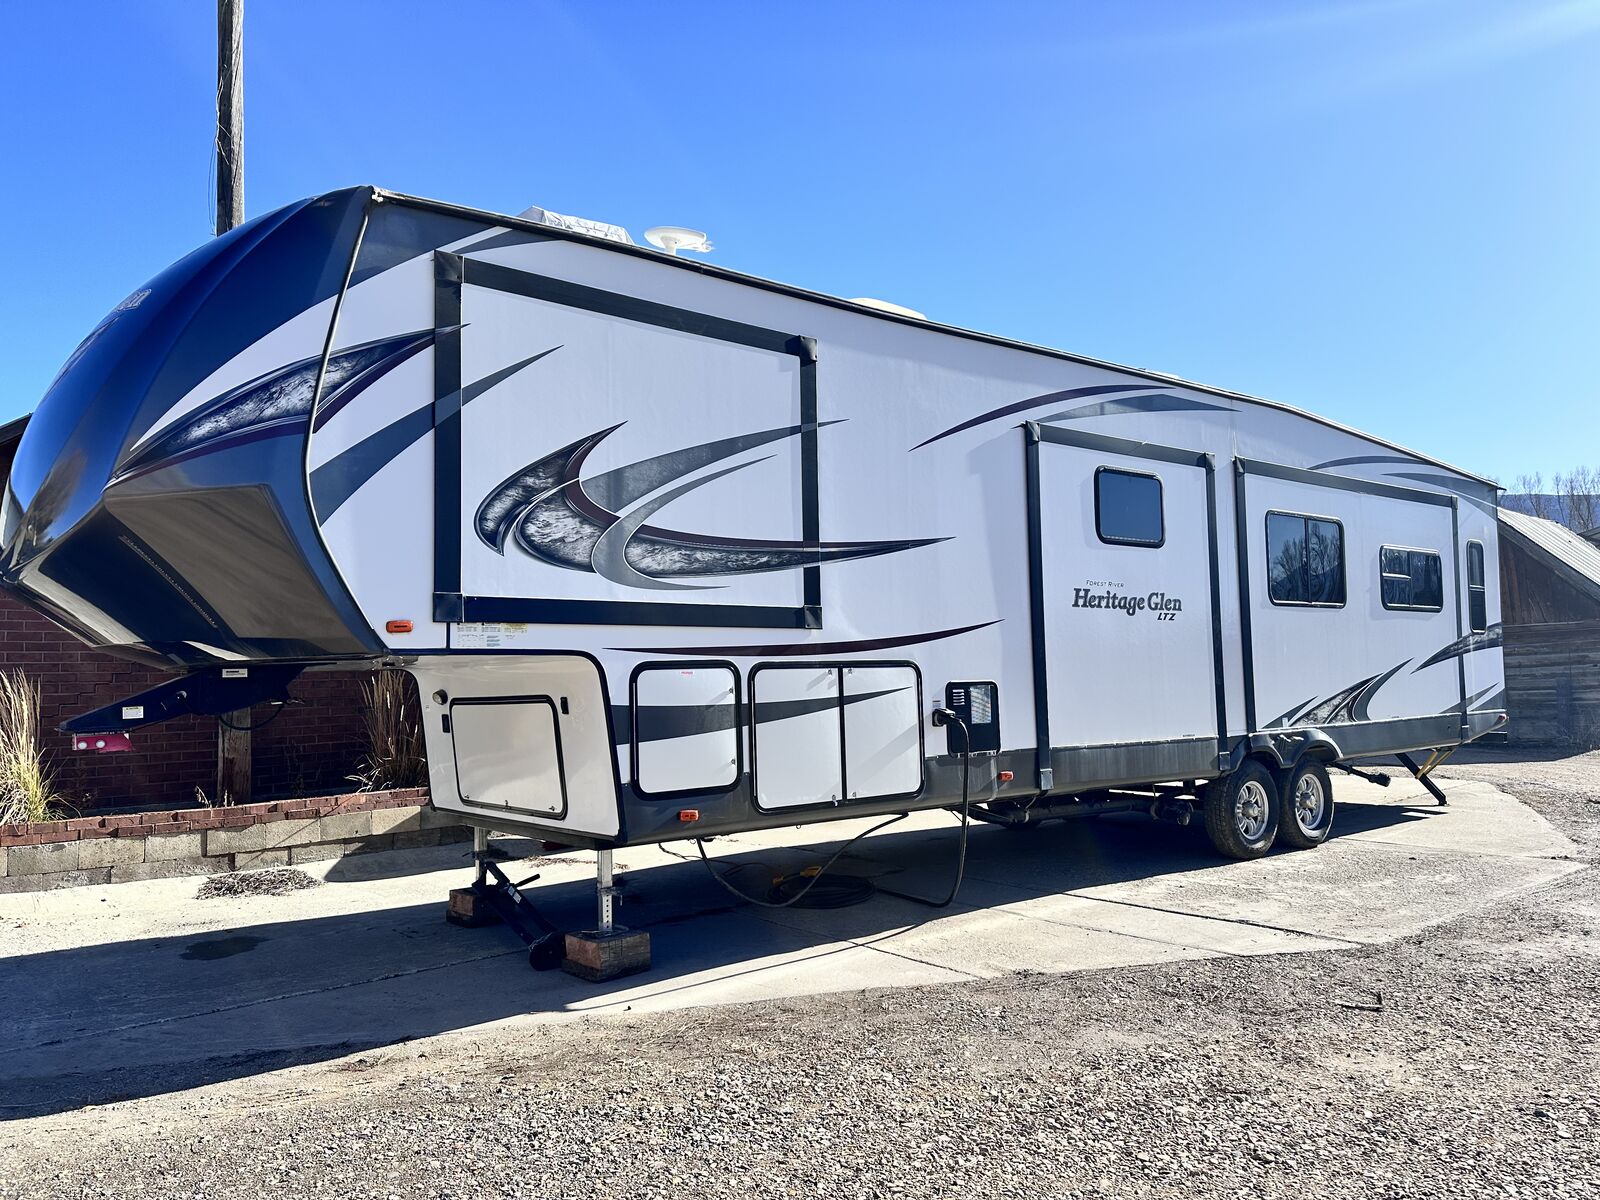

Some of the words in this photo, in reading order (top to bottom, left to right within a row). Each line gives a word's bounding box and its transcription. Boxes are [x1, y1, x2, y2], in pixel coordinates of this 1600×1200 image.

[1072, 588, 1145, 616] Heritage
[1147, 592, 1182, 612] Glen
[1157, 612, 1176, 621] LTZ
